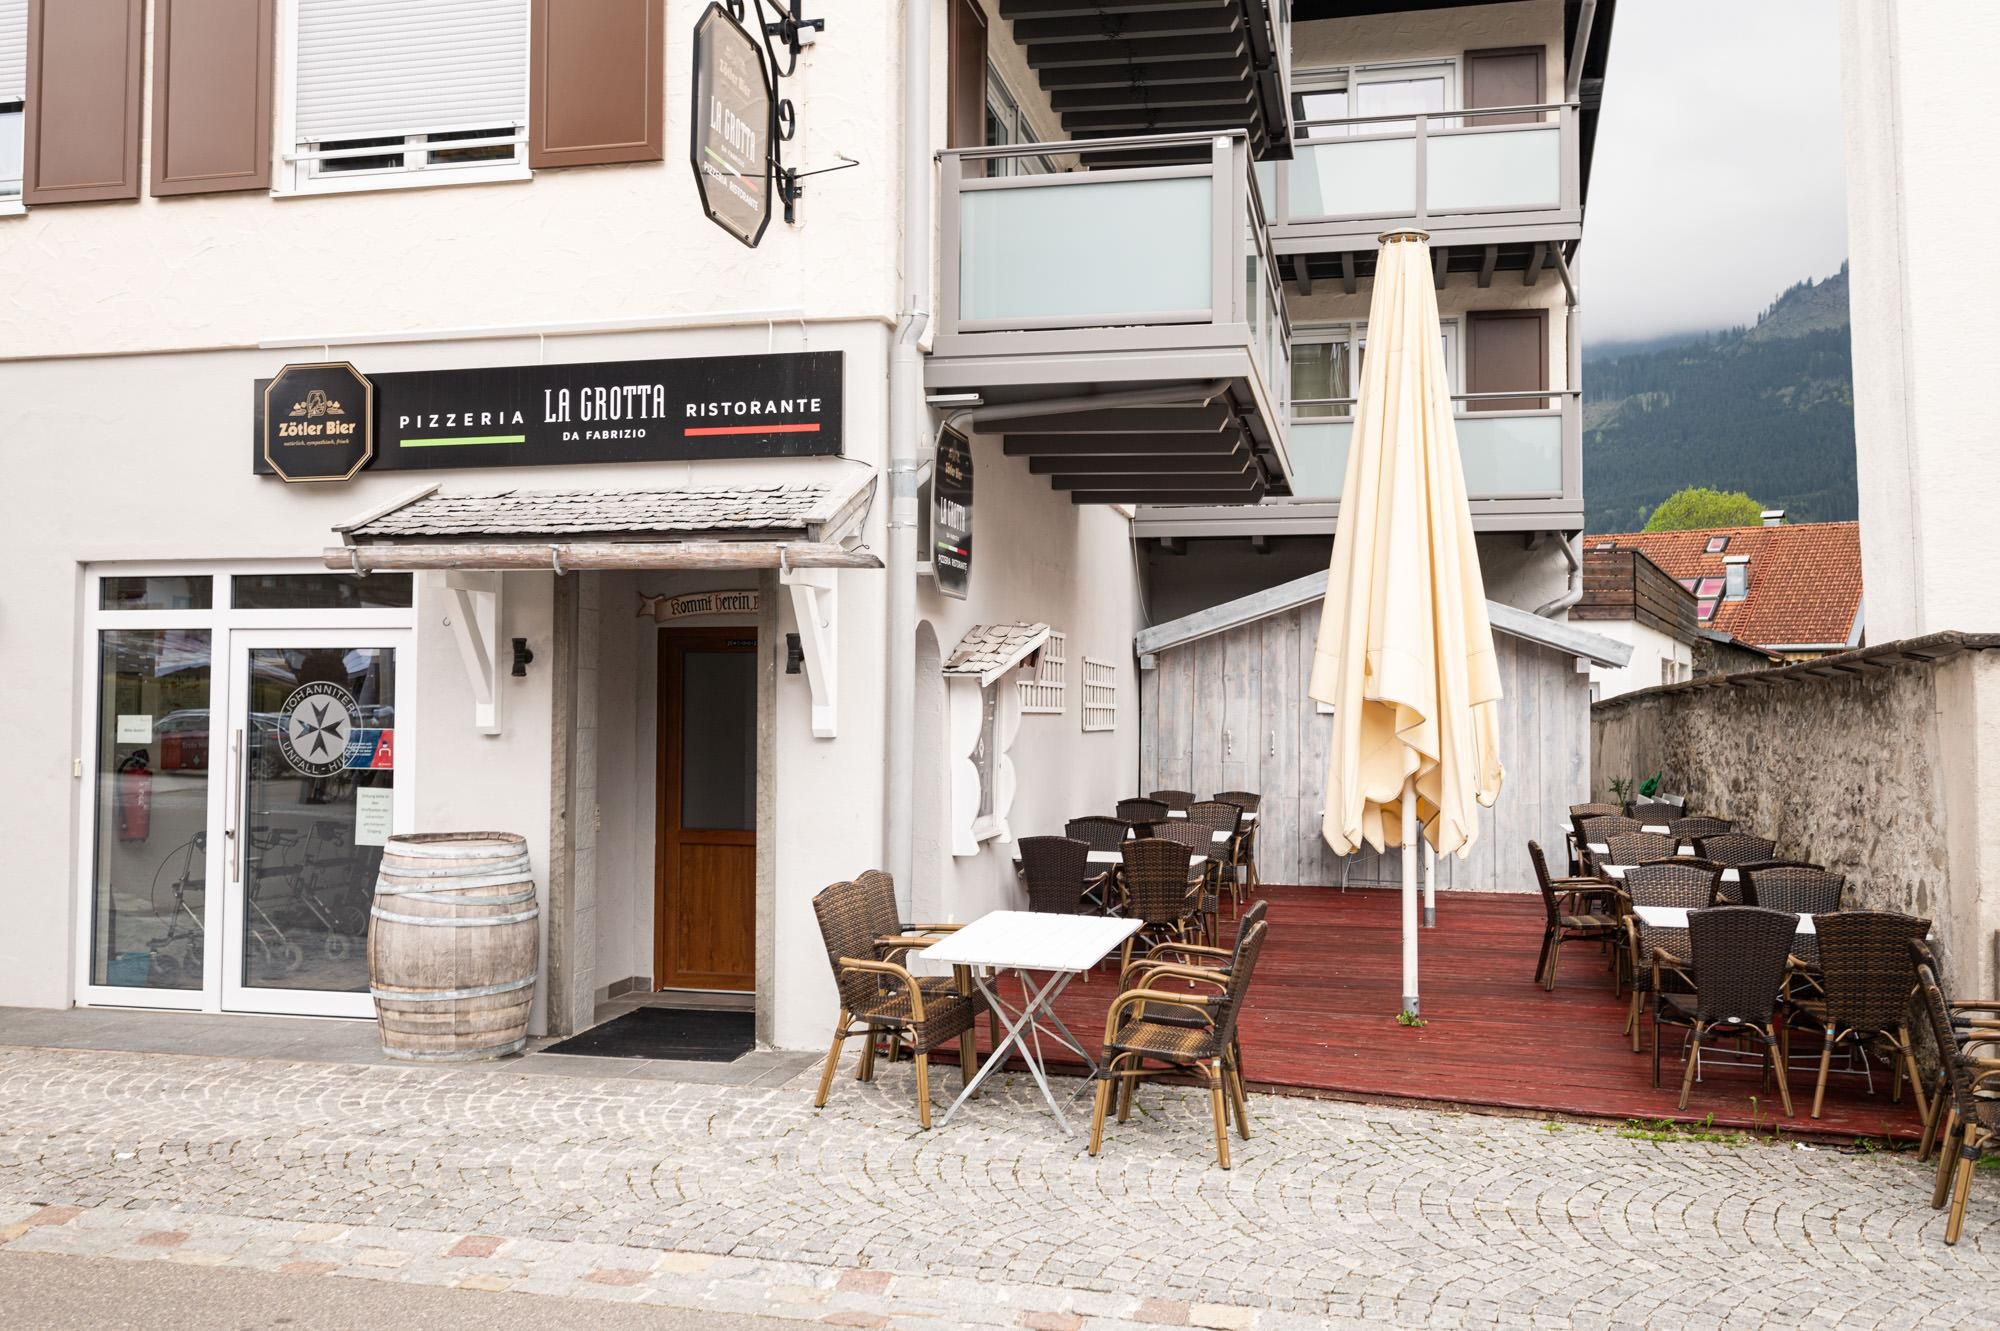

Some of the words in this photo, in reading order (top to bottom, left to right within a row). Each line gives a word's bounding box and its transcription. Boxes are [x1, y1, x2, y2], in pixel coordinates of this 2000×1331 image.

[710, 95, 722, 135] LA
[724, 108, 756, 164] GROTTA
[399, 411, 525, 429] PIZZERIA
[686, 398, 821, 417] RISTORANTE
[544, 387, 571, 423] LA
[580, 384, 666, 422] GROTTA
[279, 422, 323, 437] Zötler
[326, 420, 356, 435] Bier
[563, 431, 580, 441] DA
[586, 428, 646, 440] FABRIZIO
[285, 684, 356, 715] JOHANNITER
